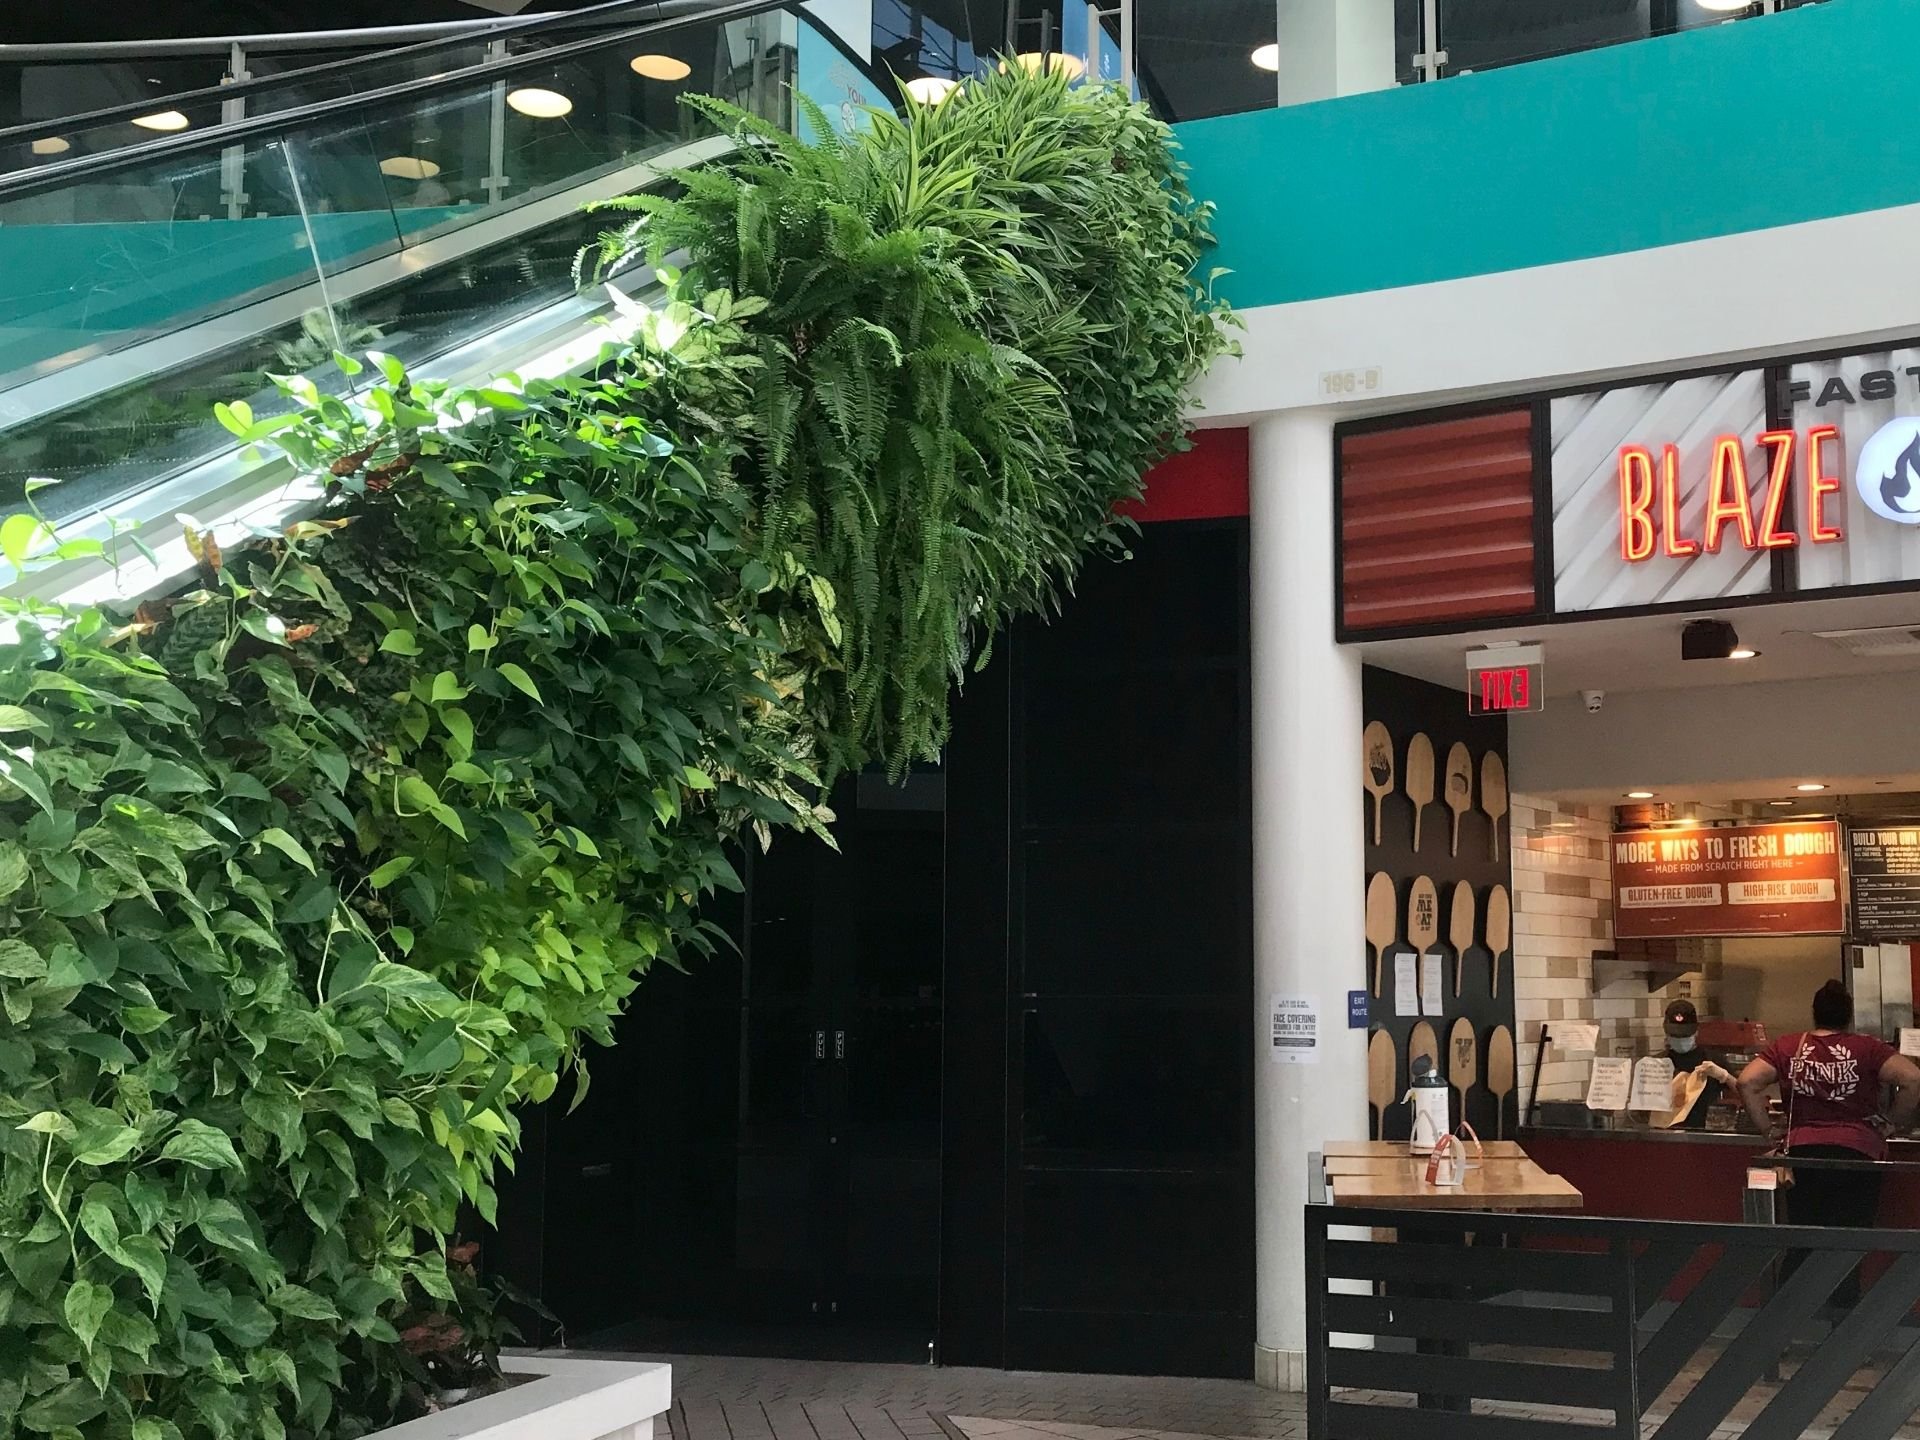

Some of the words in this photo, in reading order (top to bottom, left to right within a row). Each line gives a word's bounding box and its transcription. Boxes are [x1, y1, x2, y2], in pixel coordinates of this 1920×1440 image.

[1619, 424, 1842, 563] BLAZE
[1853, 832, 1876, 846] BUILD
[1878, 832, 1898, 846] YOUR
[1616, 841, 1656, 864] MORE
[1661, 838, 1699, 861] WAYS
[1705, 837, 1723, 859] TO
[1729, 834, 1778, 858] FRESH
[1784, 832, 1835, 856] DOUGH
[1655, 864, 1678, 874] MADE
[1680, 863, 1703, 872] FROM
[1705, 860, 1742, 872] SCRATCH
[1744, 859, 1769, 870] RIGHT
[1771, 858, 1793, 869] HERE
[1627, 887, 1682, 901] GLUTEN-FREE
[1686, 886, 1713, 899] DOUGH
[1743, 883, 1787, 897] HIGH-RISE
[1790, 882, 1819, 895] DOUGH
[1353, 996, 1365, 1005] EXIT
[1273, 1013, 1286, 1024] FACE
[1287, 1014, 1316, 1024] COVERING
[1351, 1008, 1368, 1016] ROUTE
[1788, 1058, 1860, 1084] PINK
